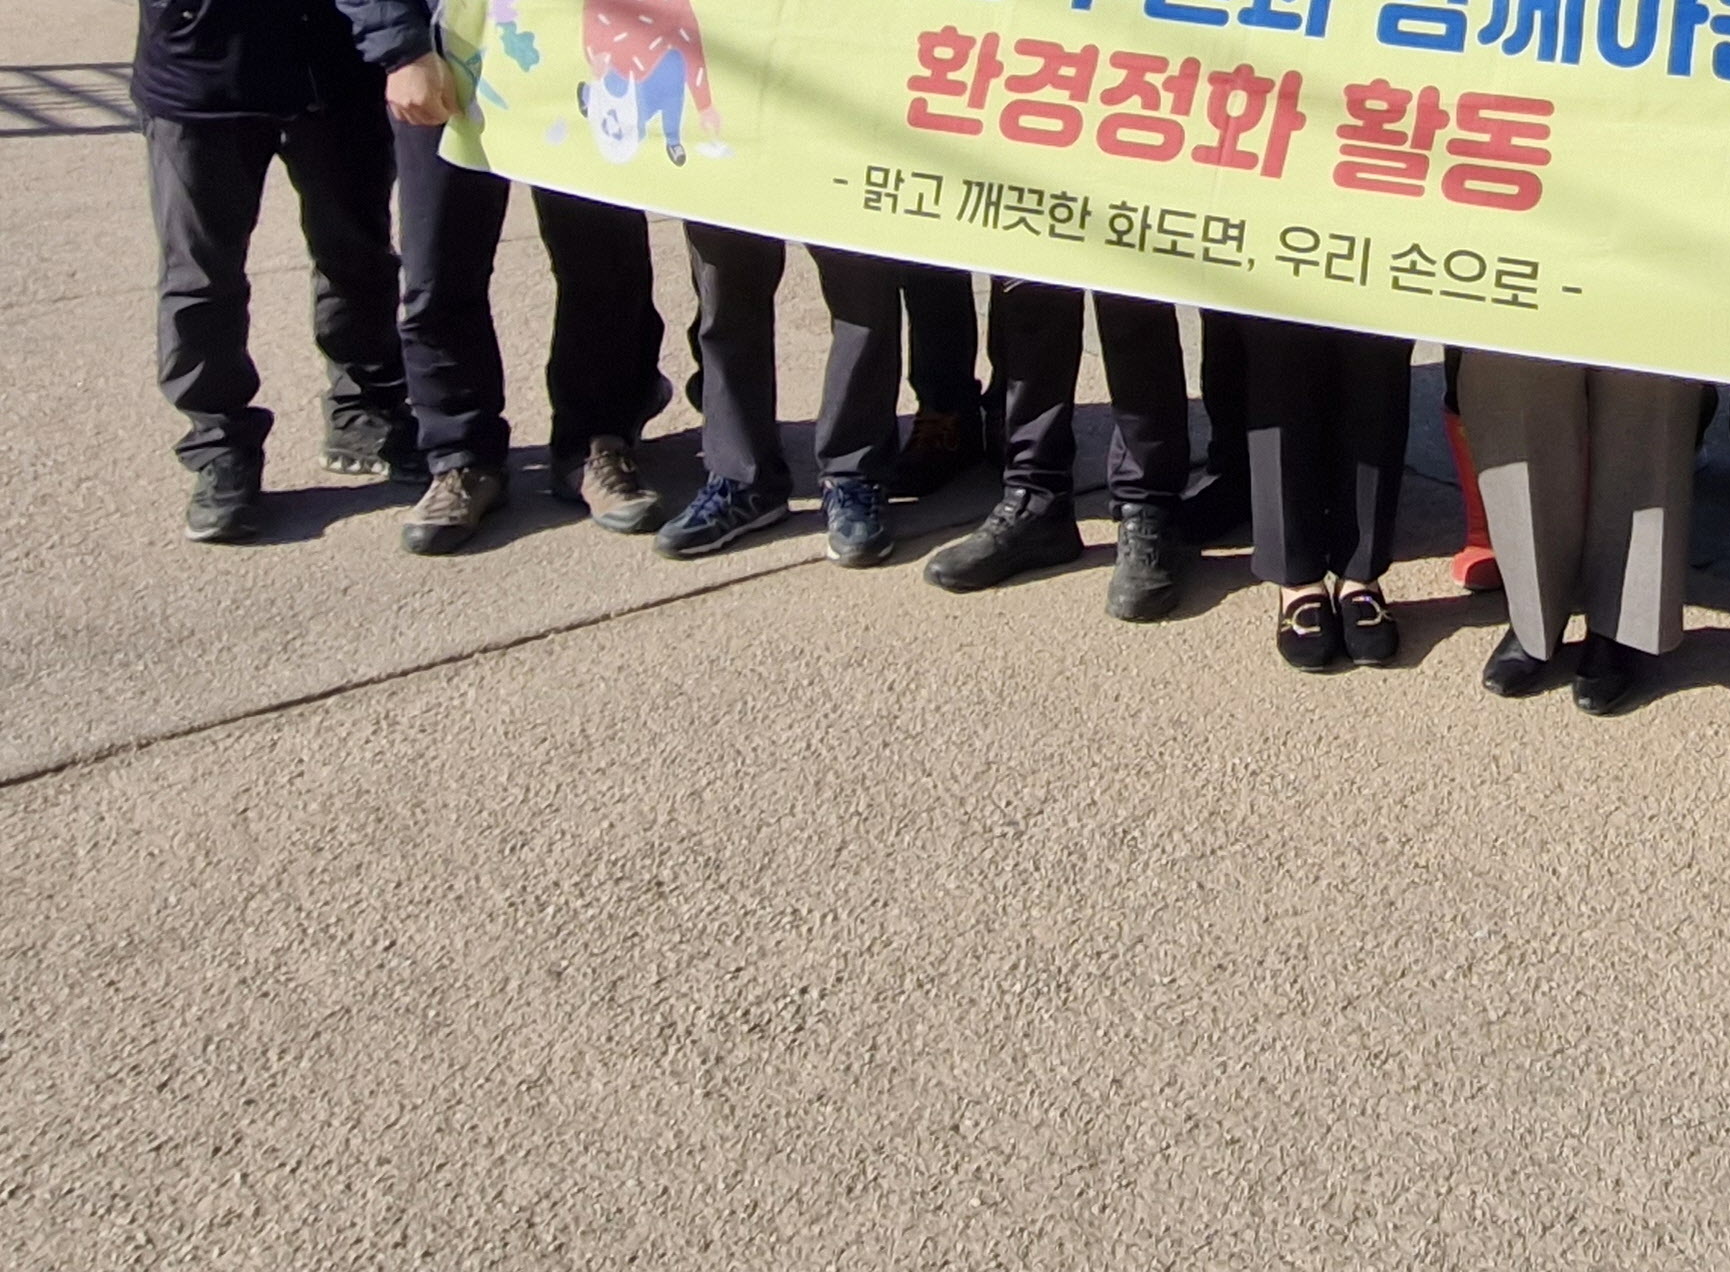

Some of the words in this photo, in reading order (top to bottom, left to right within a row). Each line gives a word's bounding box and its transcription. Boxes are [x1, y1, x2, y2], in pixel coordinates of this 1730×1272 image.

[906, 25, 1307, 179] 환경정화
[1332, 79, 1556, 212] 활동
[862, 164, 944, 220] 맑고
[955, 178, 1093, 243] 깨끗한
[1103, 199, 1256, 272] 화도면,
[1274, 225, 1372, 287] 우리
[1389, 241, 1540, 311] 손으로
